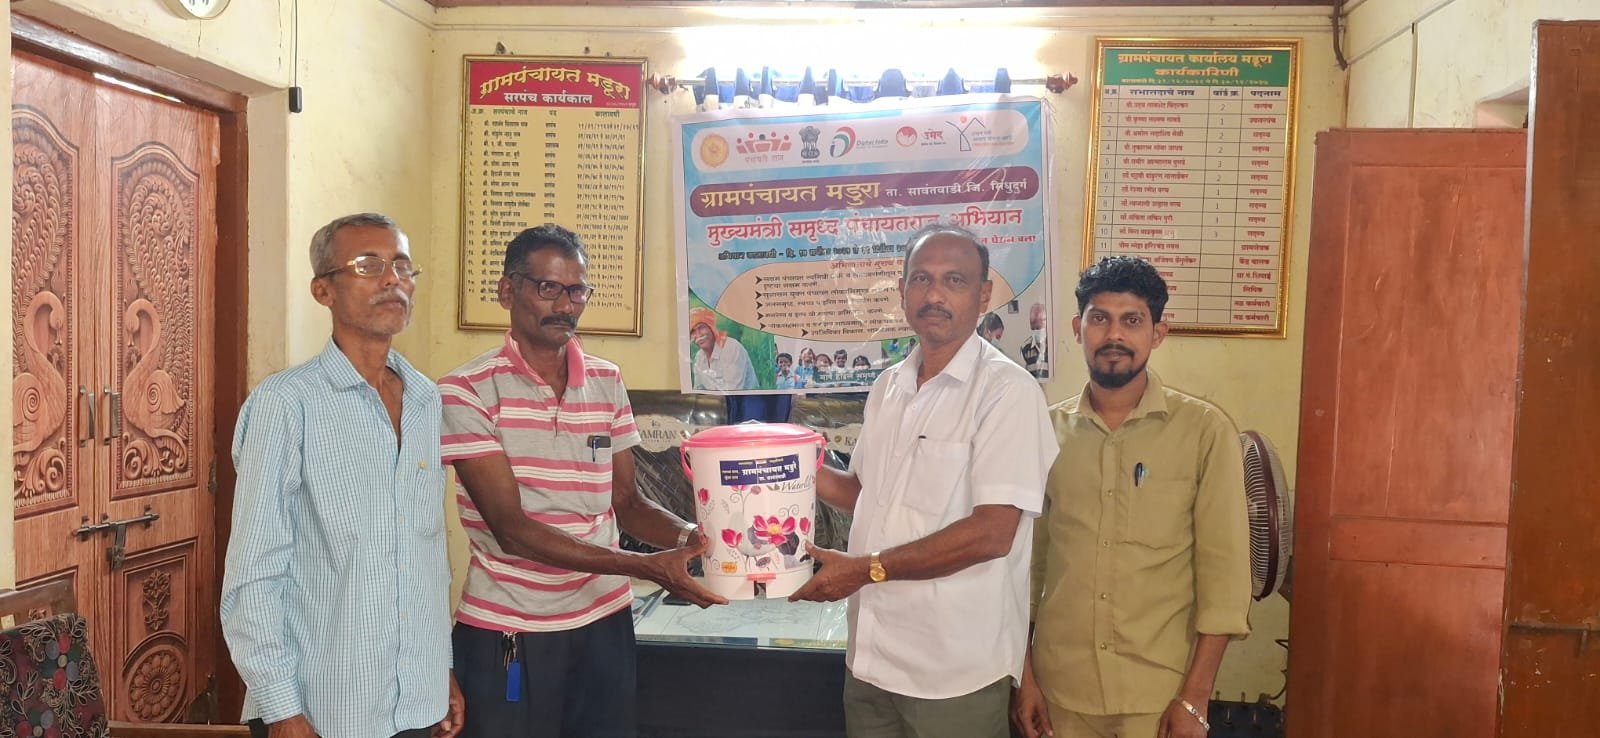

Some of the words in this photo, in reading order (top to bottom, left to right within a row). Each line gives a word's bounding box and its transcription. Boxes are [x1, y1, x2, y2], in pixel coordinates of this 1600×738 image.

[1118, 51, 1185, 64] ग्रामपंचायत
[1188, 51, 1238, 64] कार्यालय
[1155, 67, 1240, 77] कार्यकारिणी
[479, 66, 582, 99] ग्रामपंचायत
[504, 89, 537, 104] सरपंच
[541, 90, 592, 104] कार्यकाल
[1176, 88, 1195, 97] नाव
[1249, 90, 1281, 99] पदनाम
[700, 182, 818, 209] ग्रामपंचायत
[825, 182, 881, 207] मडुरा
[885, 187, 903, 197] ता.
[907, 183, 961, 196] सावंतवाडी
[706, 217, 783, 247] मुख्यमंत्री
[948, 206, 1022, 229] अभियान
[640, 429, 677, 440] AMRAN
[741, 465, 783, 476] ग्रामपंचायत
